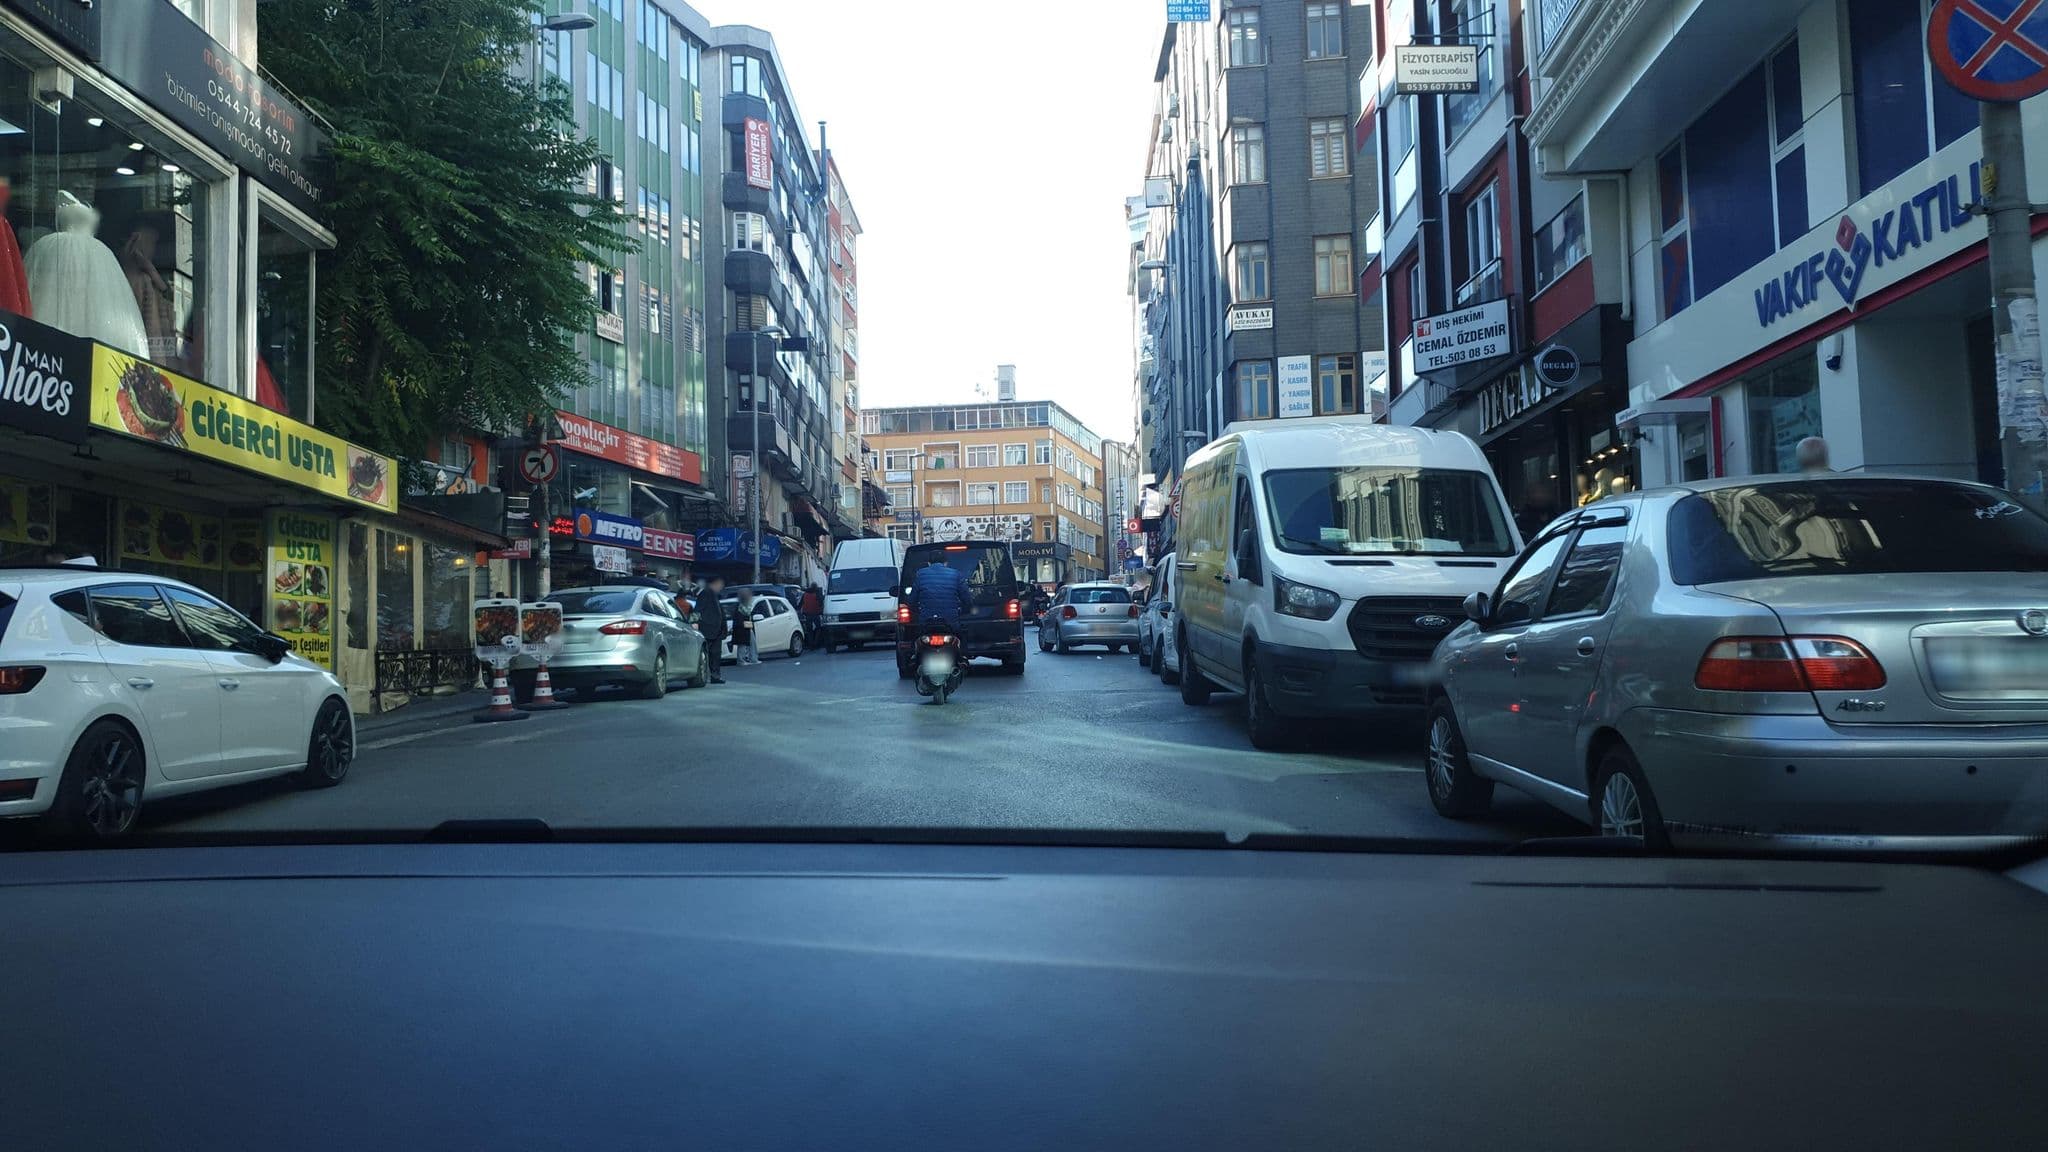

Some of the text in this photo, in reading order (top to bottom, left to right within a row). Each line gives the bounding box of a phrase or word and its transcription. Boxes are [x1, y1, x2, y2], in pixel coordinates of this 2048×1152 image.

[1402, 52, 1474, 63] FİZYOTERAPİST
[1406, 82, 1472, 91] 0539 607 78 19
[208, 79, 291, 155] 0544 724 45 72
[749, 133, 761, 178] BARİYER
[1754, 251, 1825, 328] VAKIF
[1234, 310, 1271, 319] AVUKAT
[1435, 307, 1485, 331] DİŞ HEKİMİ
[1416, 321, 1507, 354] CEMAL ÖZDEMİR
[25, 347, 63, 375] MAN
[1428, 344, 1496, 367] TEL:503 08 53
[1542, 362, 1576, 370] DEGAJE
[191, 396, 336, 479] CİĞERCİ USTA
[278, 515, 330, 562] CİĞERCİ USTA
[595, 519, 643, 542] METRO
[300, 638, 330, 656] Çeşitleri
[1835, 699, 1887, 713] Albea
